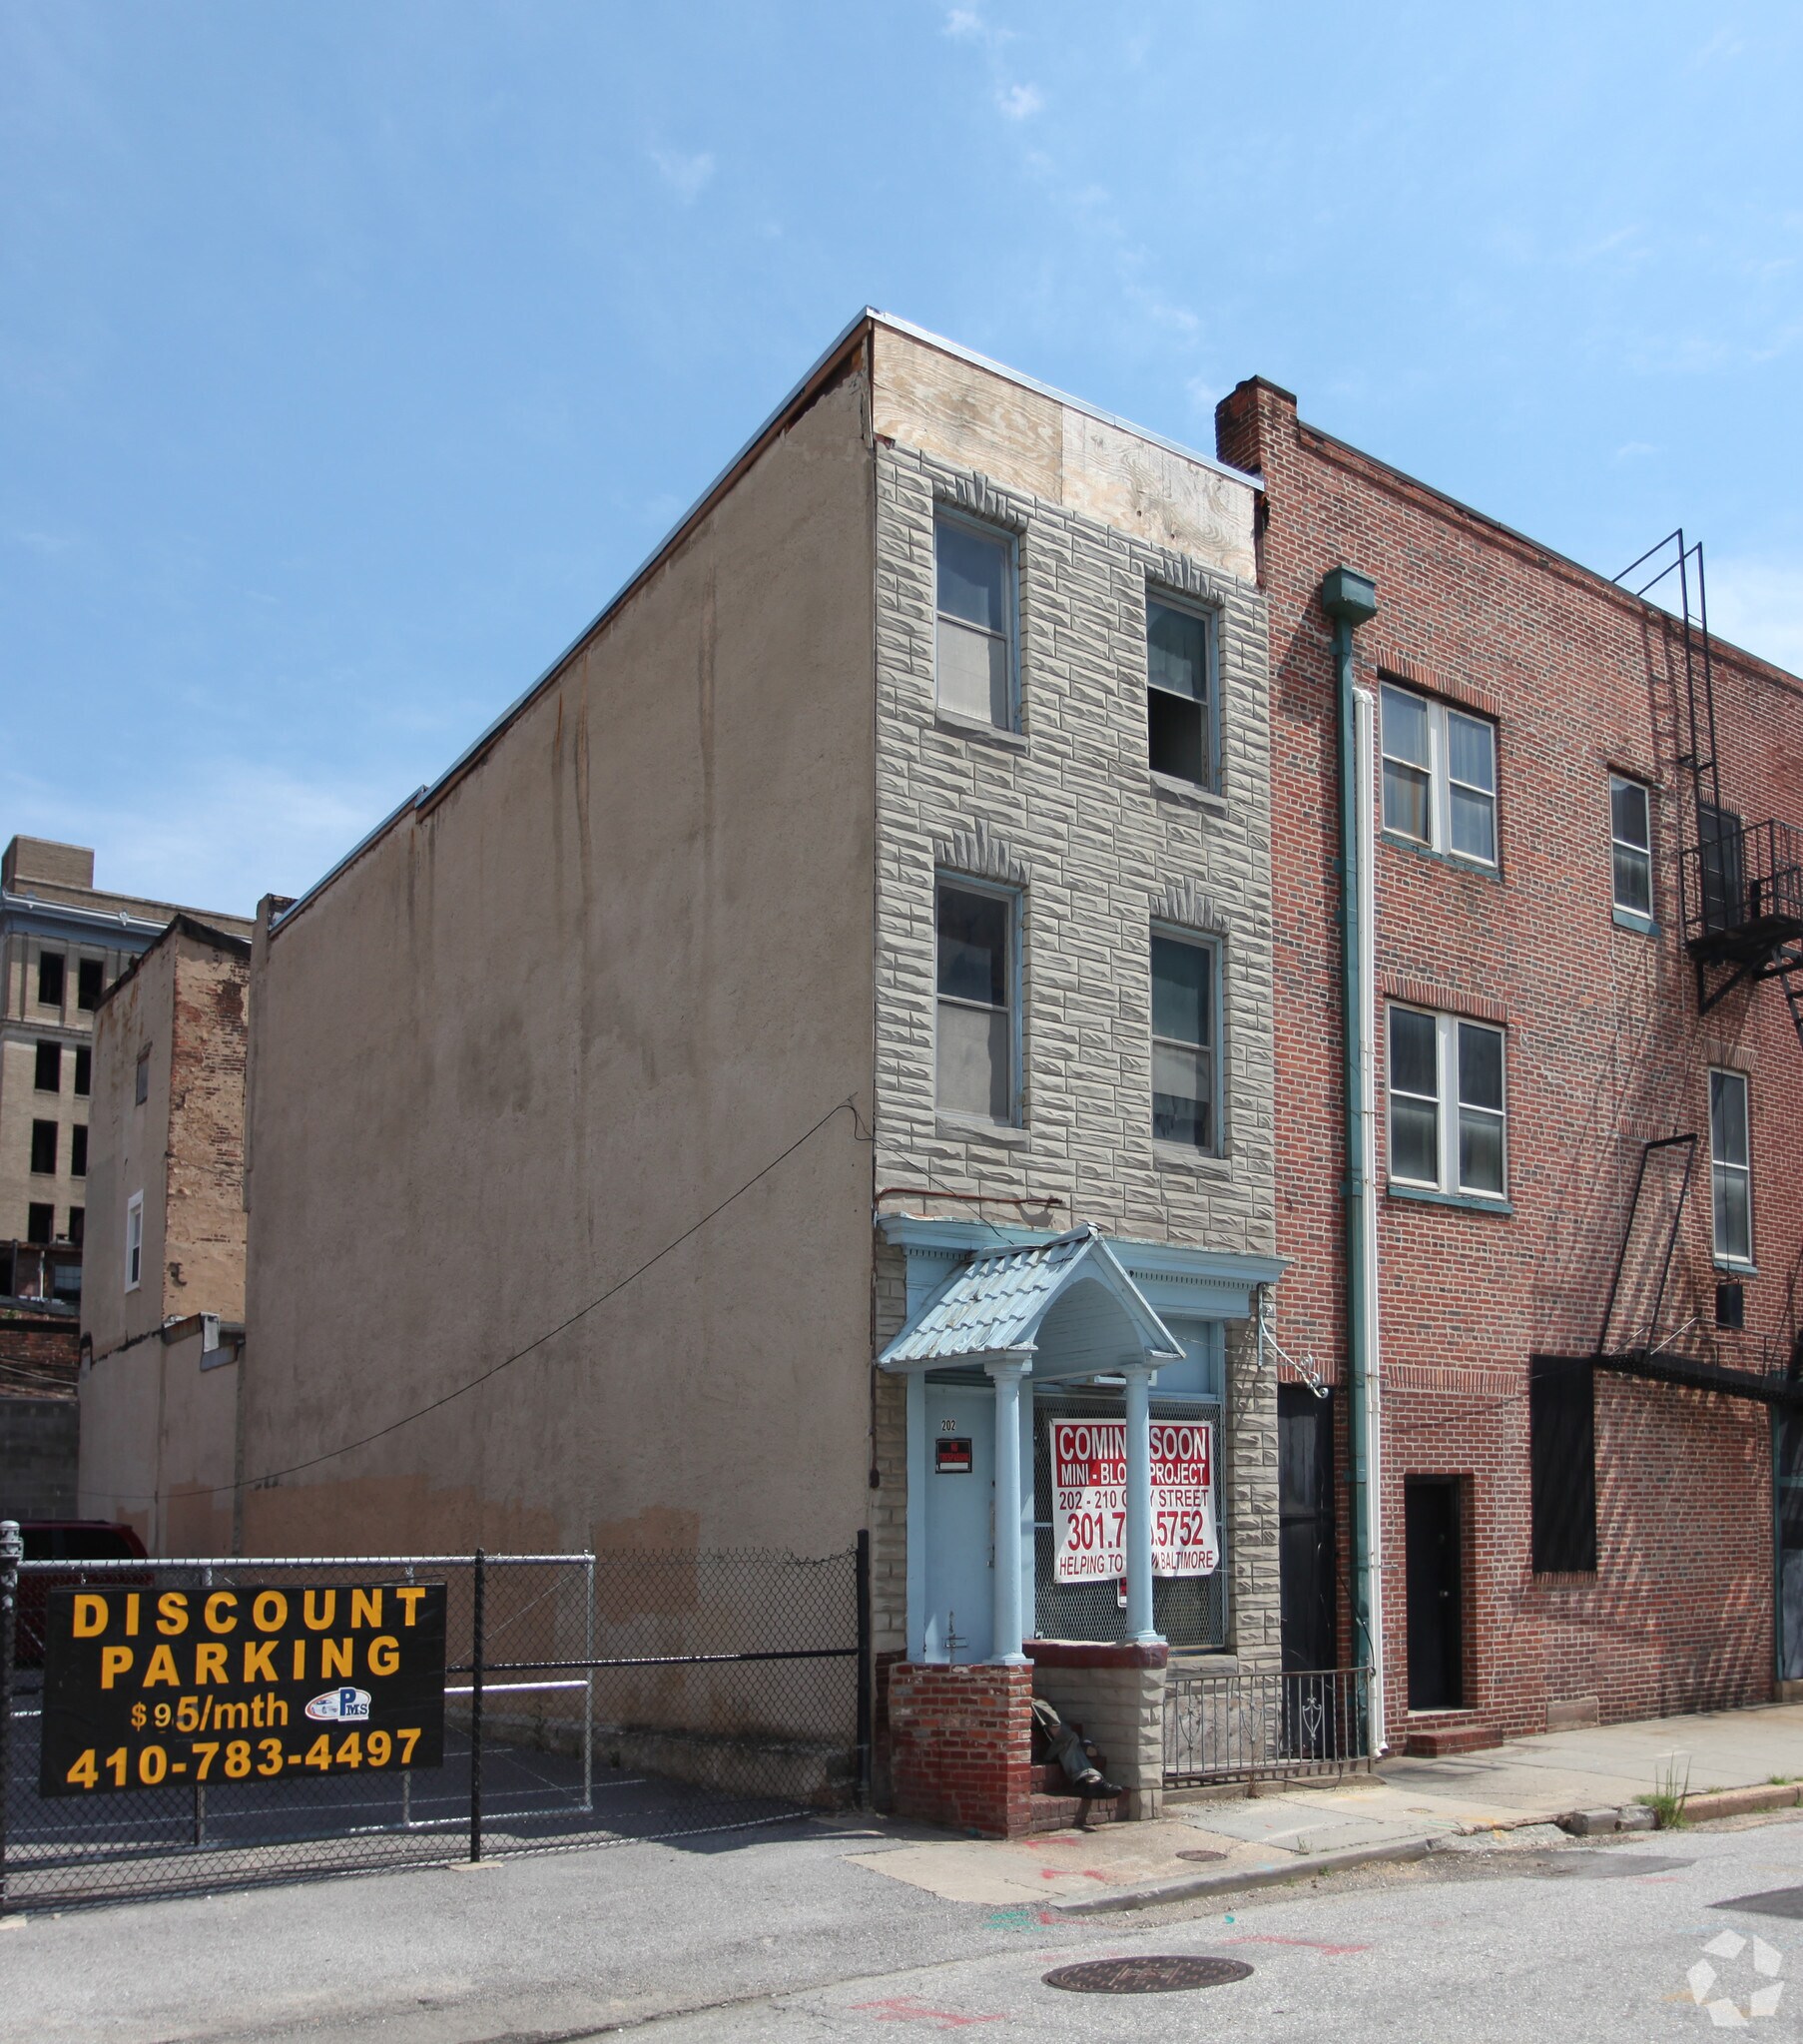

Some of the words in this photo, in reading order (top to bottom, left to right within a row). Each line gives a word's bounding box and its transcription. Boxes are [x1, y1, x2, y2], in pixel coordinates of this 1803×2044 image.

[941, 1419, 956, 1432] 202
[1059, 1426, 1127, 1461] COMIN
[1150, 1427, 1206, 1461] SOON
[1061, 1463, 1089, 1486] MINI
[1100, 1463, 1127, 1485] BLO
[1149, 1463, 1206, 1485] PROJECT
[1059, 1491, 1082, 1511] 202
[1095, 1490, 1117, 1509] 210
[1159, 1489, 1209, 1507] STREET
[1067, 1510, 1204, 1551] 301.7.5752
[1059, 1555, 1105, 1576] HELPING
[1108, 1553, 1123, 1573] TO
[1161, 1550, 1214, 1570] BALTIMORE
[73, 1588, 426, 1638] DISCOUNT
[102, 1636, 400, 1690] PARKING
[339, 1689, 368, 1716] PMS
[67, 1727, 422, 1789] 410-783-4497
